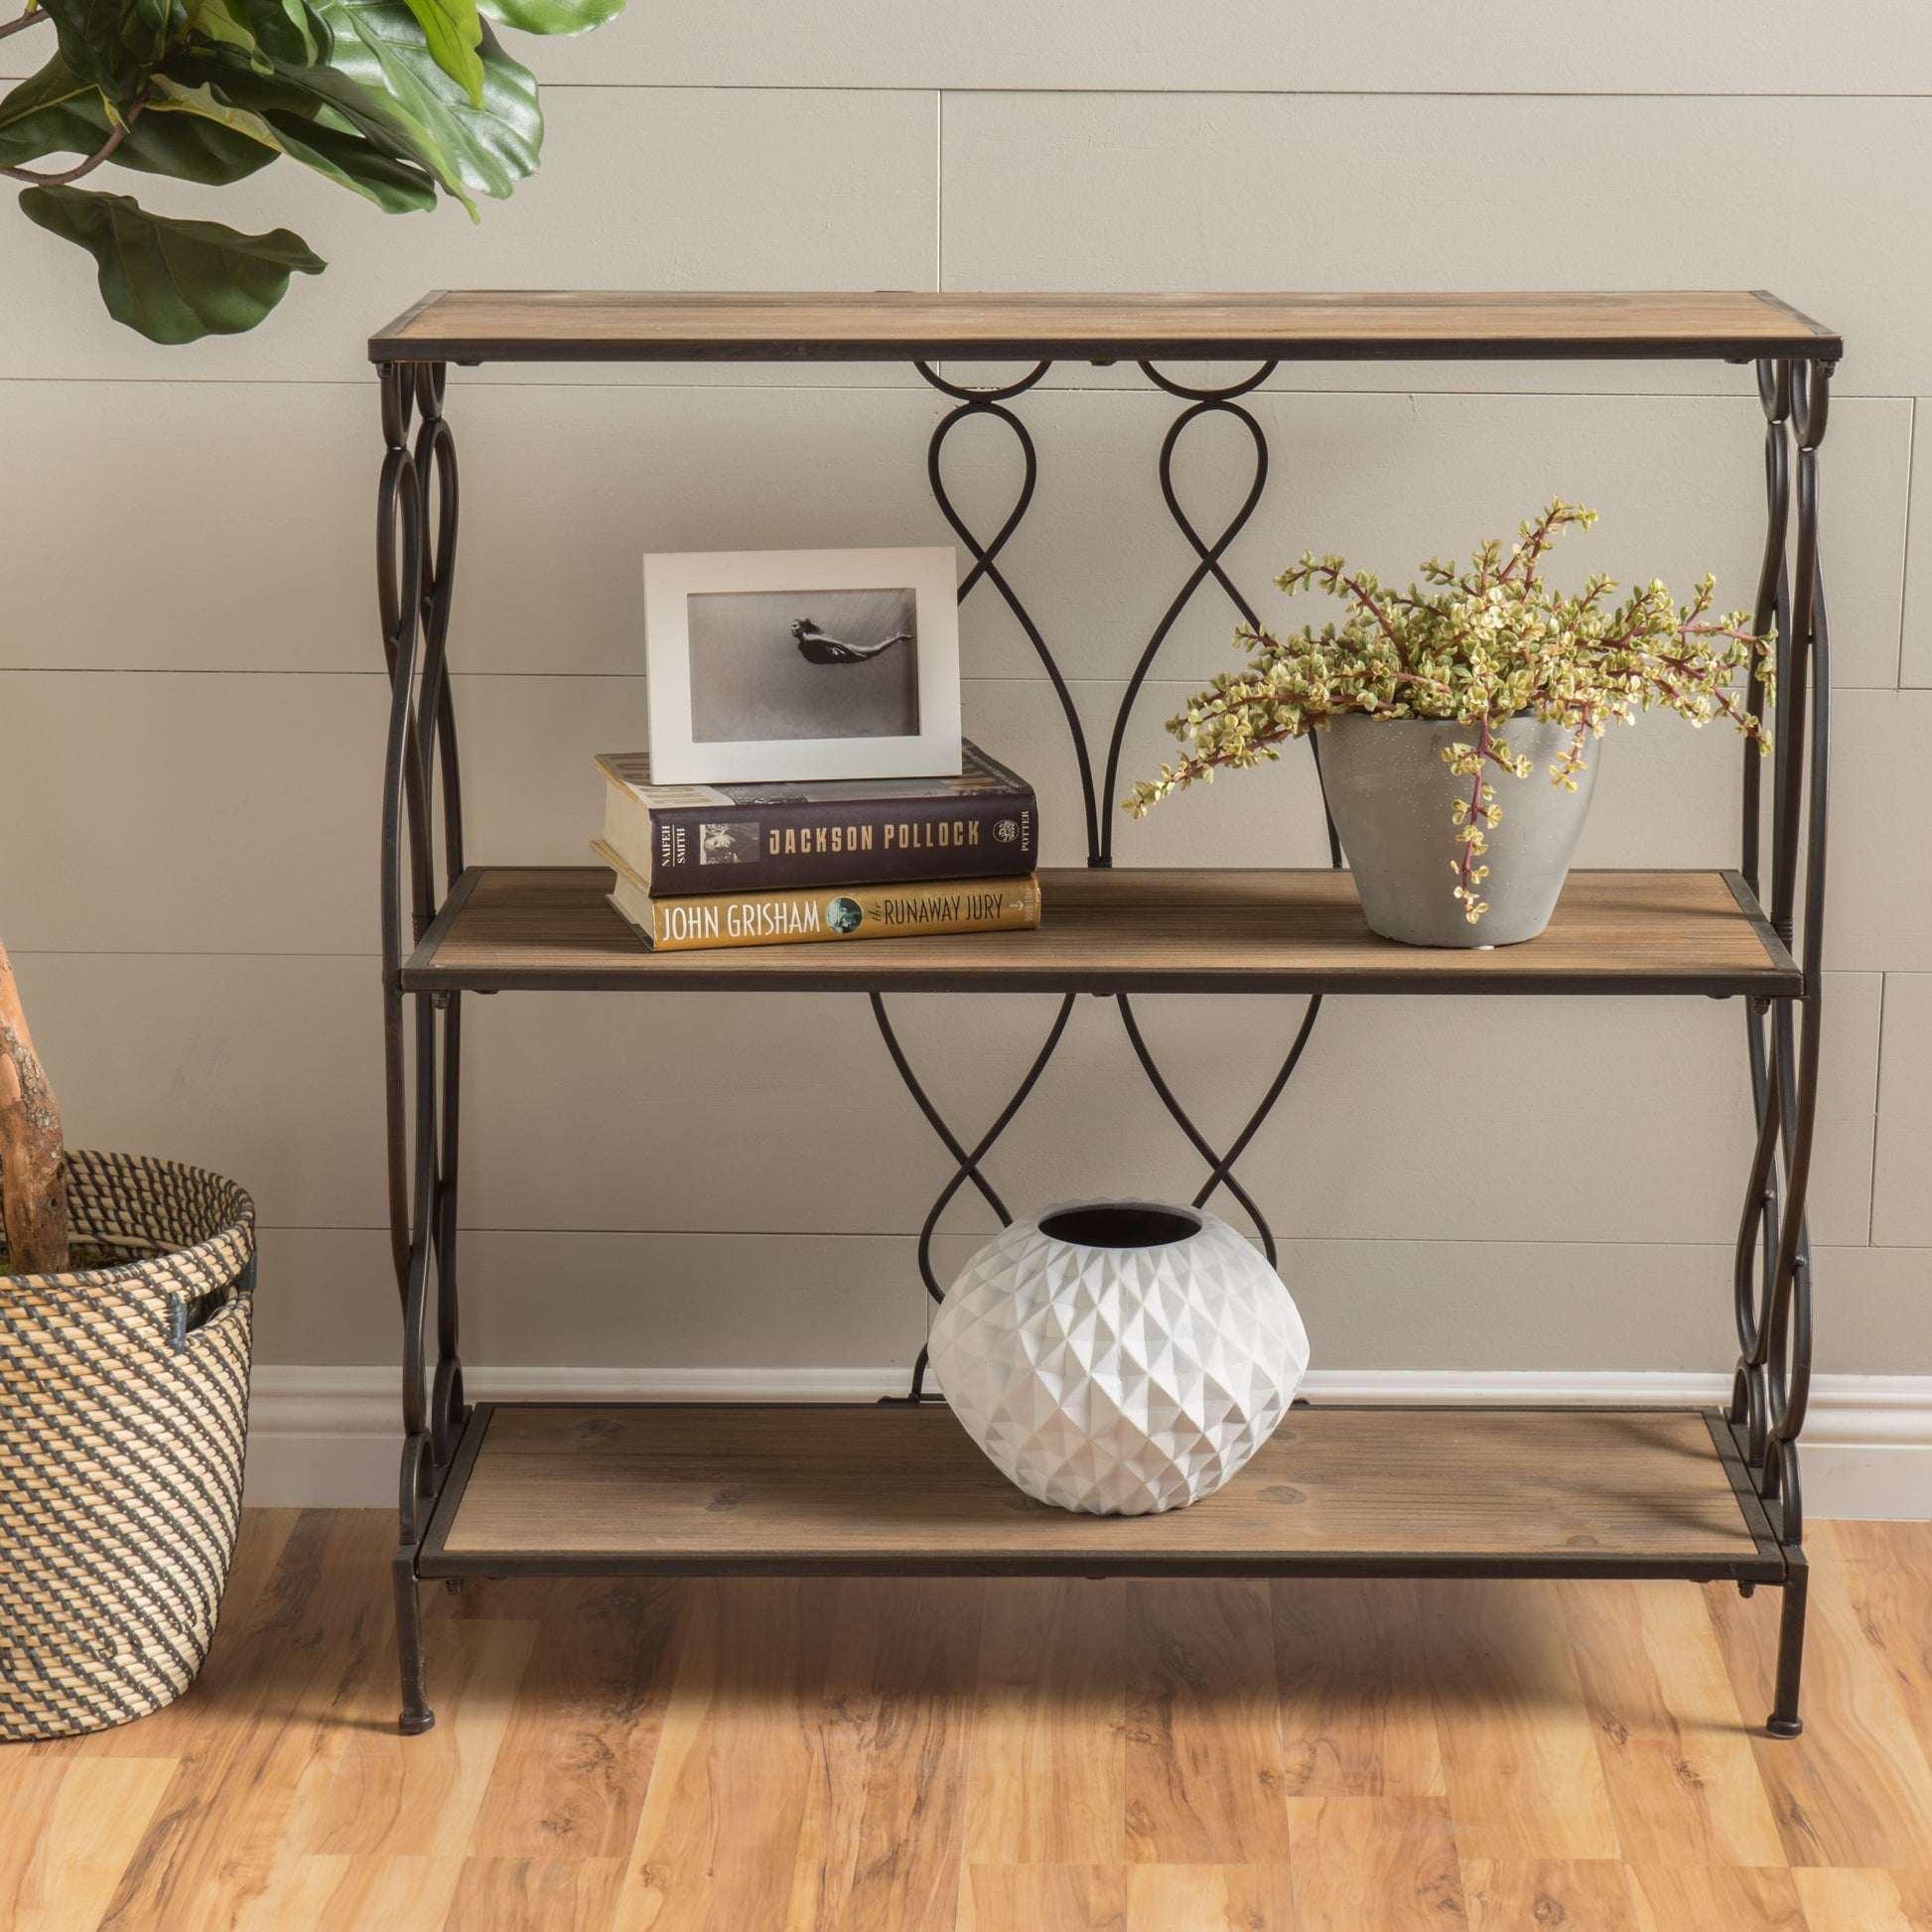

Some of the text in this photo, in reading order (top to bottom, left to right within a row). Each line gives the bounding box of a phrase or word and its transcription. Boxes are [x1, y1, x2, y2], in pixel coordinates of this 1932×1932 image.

[661, 825, 671, 867] NAIFEH
[676, 828, 686, 864] SMITH
[769, 820, 980, 855] JACKSON POLLOCK
[1021, 810, 1030, 852] POTTER
[662, 899, 821, 941] JOHN GRISHAM
[867, 894, 1003, 925] the RUNAWAY JURY
